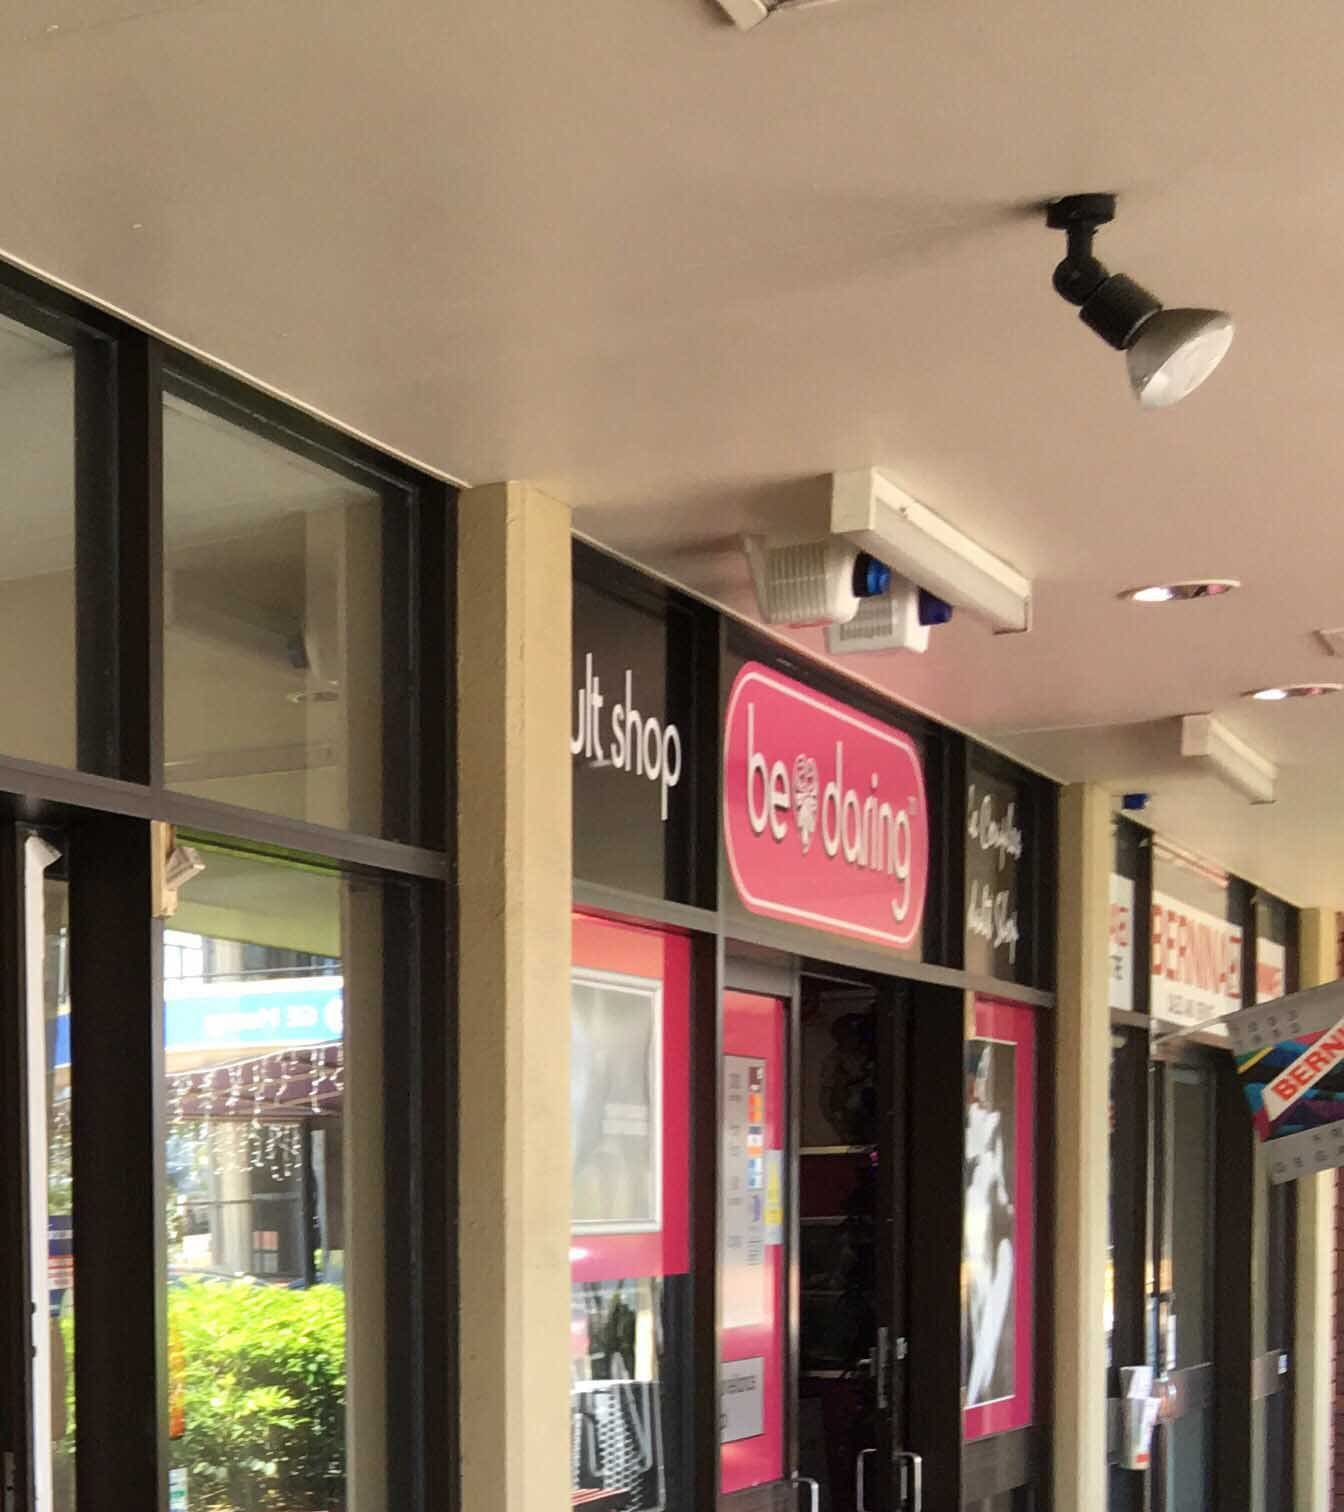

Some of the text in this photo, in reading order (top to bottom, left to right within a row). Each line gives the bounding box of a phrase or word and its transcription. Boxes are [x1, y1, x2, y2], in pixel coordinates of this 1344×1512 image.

[571, 652, 682, 821] ult shop
[745, 702, 790, 841] be
[821, 740, 912, 923] daring
[1272, 1025, 1344, 1102] BERN
